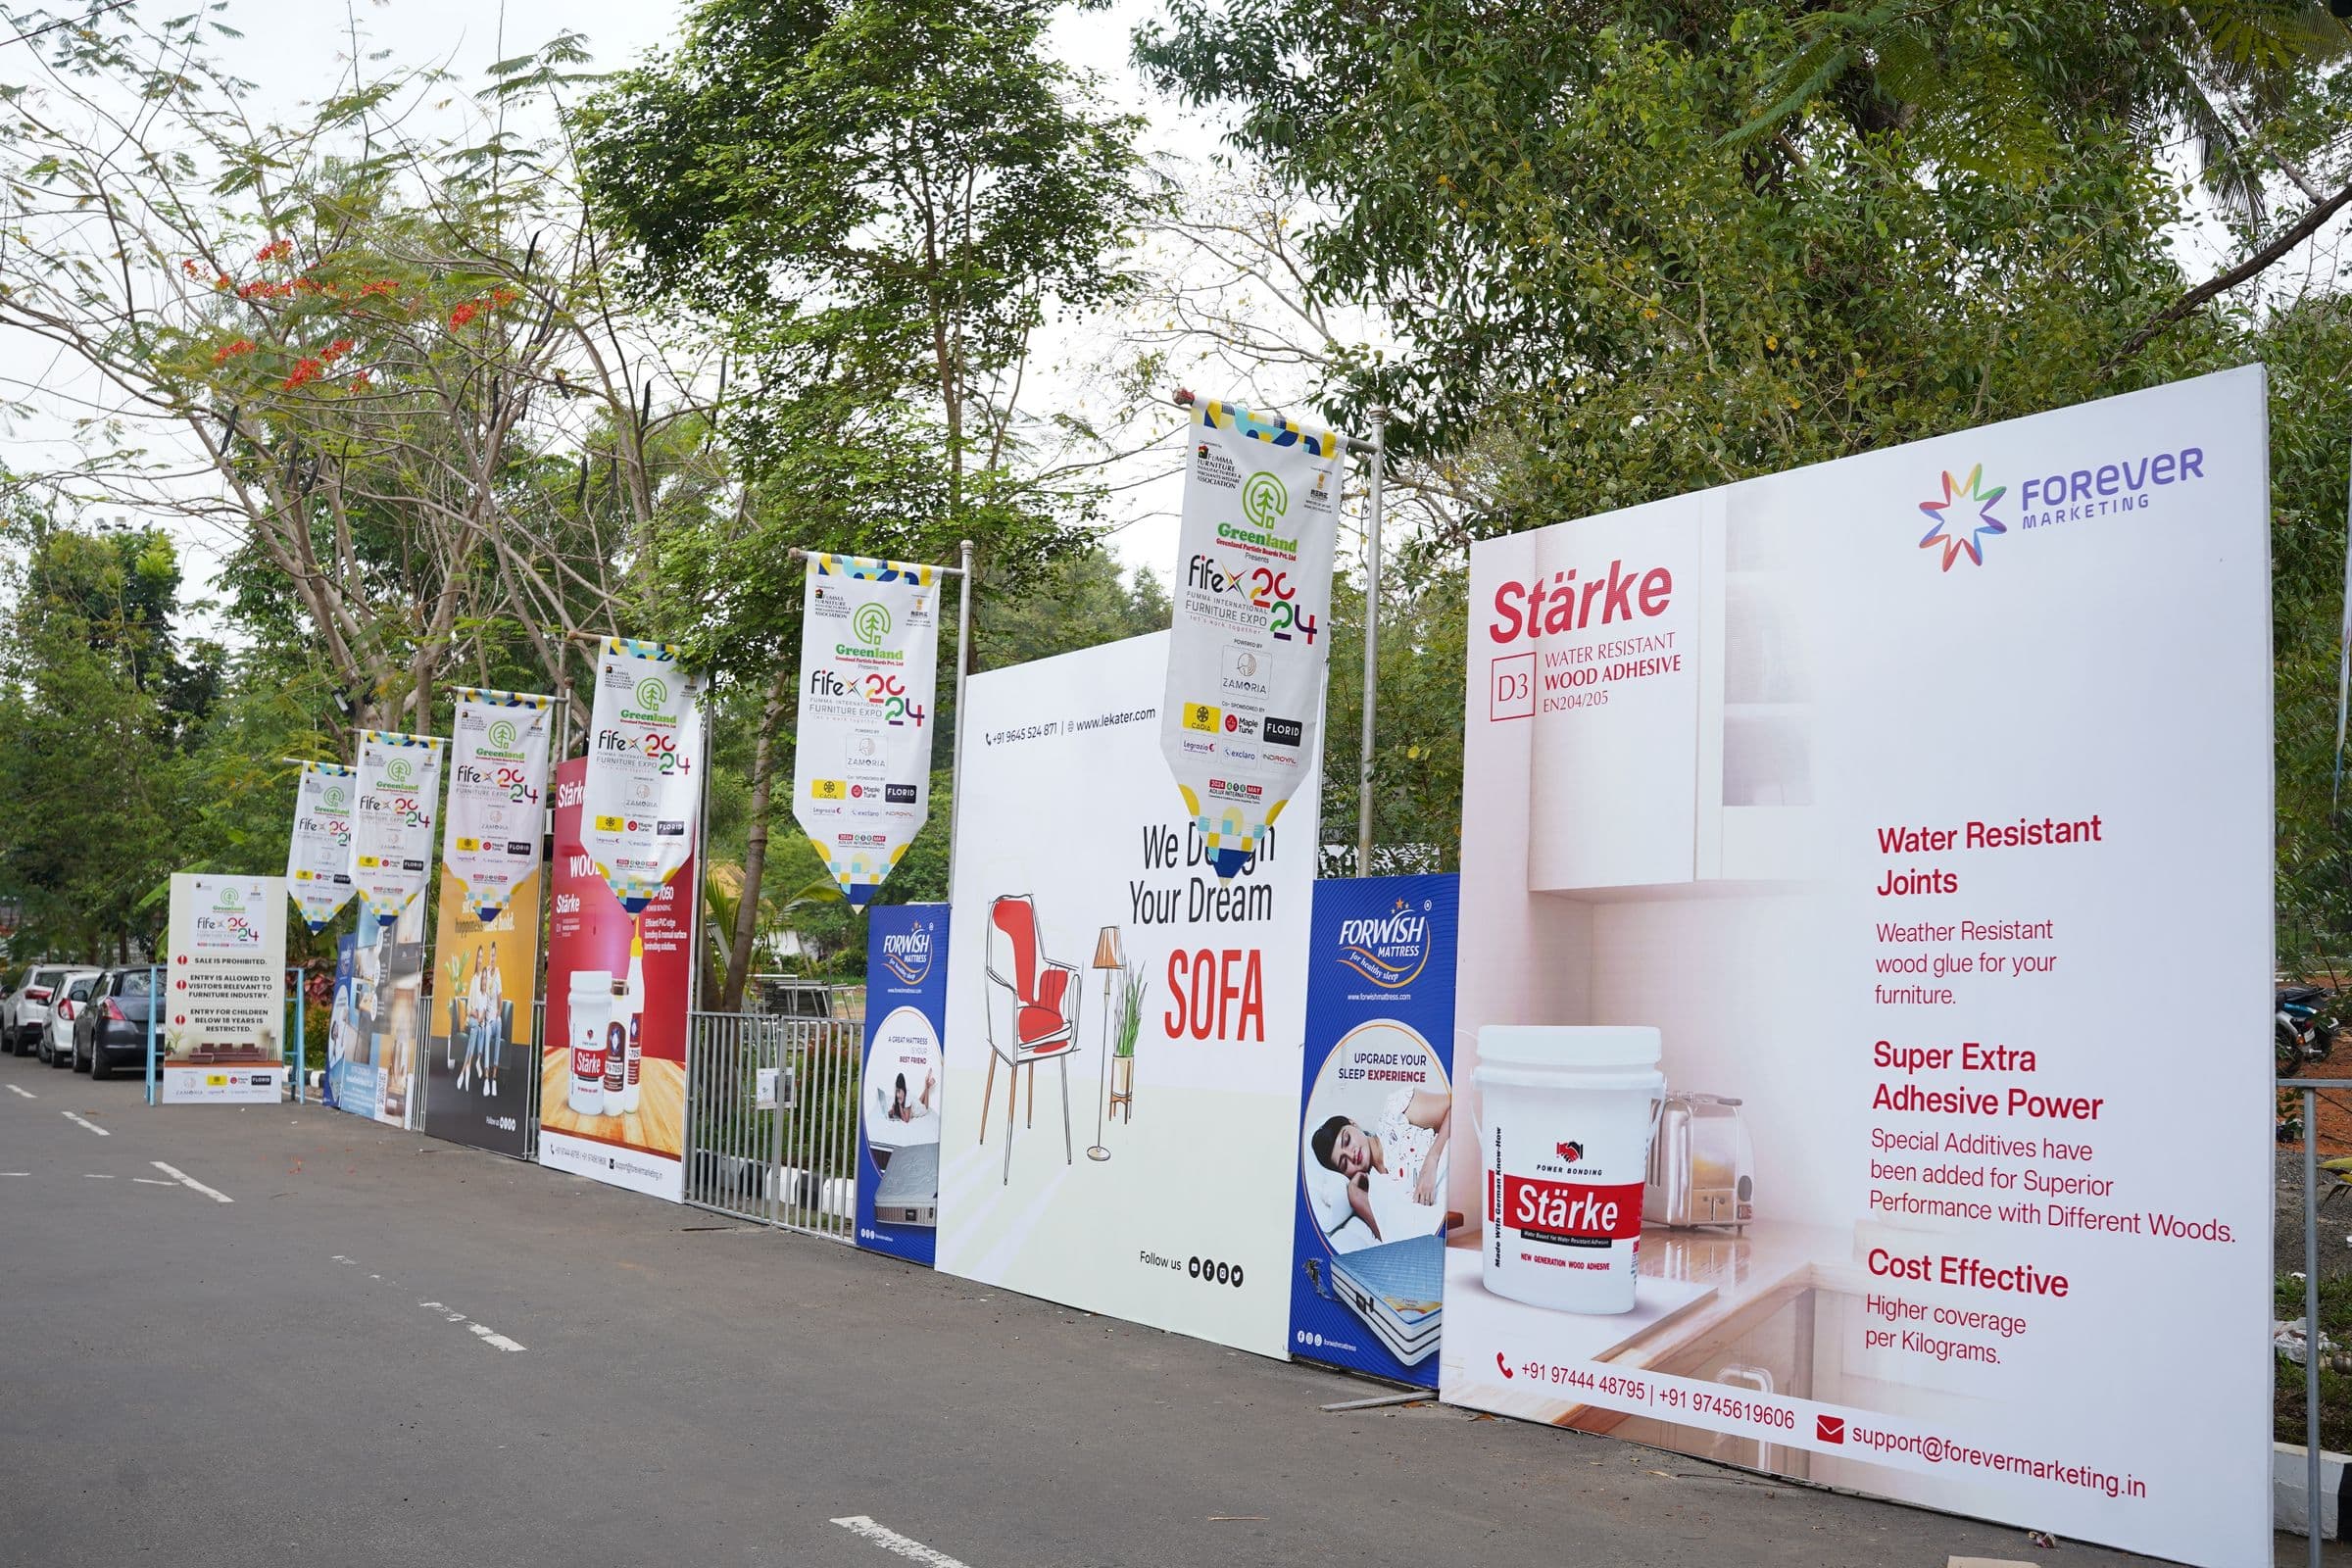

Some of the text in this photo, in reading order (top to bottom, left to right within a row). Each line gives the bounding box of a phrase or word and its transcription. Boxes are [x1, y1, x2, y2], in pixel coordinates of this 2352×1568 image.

[2023, 494, 2149, 529] MARKETING
[1217, 522, 1298, 554] Greenland
[1186, 600, 1267, 626] FURNITURE EXPO
[1187, 591, 1268, 614] FUMMA INTERNATIONAL
[1490, 560, 1672, 644] Stärke
[836, 644, 904, 661] Greenland
[1545, 631, 1677, 668] WATER RESISTANT
[1223, 677, 1266, 694] ZAMORIA
[1498, 672, 1529, 702] D3
[1544, 655, 1681, 691] WOOD ADHESIVE
[809, 705, 882, 717] FURNITURE EXPO
[1544, 690, 1608, 712] EN204/205
[620, 710, 677, 723] Greenland
[1077, 708, 1155, 731] www.lekater.com
[1239, 717, 1258, 728] Maple
[1239, 725, 1253, 735] Tune
[1267, 723, 1298, 736] FLORID
[993, 722, 1057, 745] +91 9645 524 871
[558, 780, 587, 808] Stärk
[887, 788, 915, 797] FLORID
[1144, 824, 1178, 869] We
[1878, 814, 2102, 854] Water Resistant
[1877, 868, 1958, 896] Joints
[1130, 877, 1272, 924] Your Dream
[1339, 916, 1425, 948] FORWISH
[1877, 918, 2053, 943] Weather Resistant
[1378, 945, 1420, 957] MATTRESS
[1876, 952, 2057, 977] wood glue for your
[1349, 952, 1399, 983] for healthy sleep
[1164, 949, 1264, 1042] SOFA
[1875, 984, 1956, 1004] furniture.
[1354, 1054, 1427, 1066] UPGRADE YOUR
[1874, 1041, 2036, 1074] Super Extra
[1339, 1067, 1426, 1083] SLEEP EXPERIENCE
[1873, 1083, 2104, 1120] Adhesive Power
[1872, 1128, 2093, 1160] Special Additives have
[1537, 1164, 1563, 1173] POWER
[1871, 1159, 2114, 1198] been added for Superior
[1516, 1184, 1619, 1232] Stärke
[1870, 1190, 2236, 1243] Performance with Different Woods.
[1140, 1250, 1182, 1271] Follow us
[1534, 1254, 1566, 1267] GENERATION
[1868, 1248, 2069, 1298] Cost Effective
[1866, 1294, 2027, 1338] Higher coverage
[1866, 1329, 2001, 1364] per Kilograms.
[1522, 1363, 1795, 1430] +91 97444 48795 +91 9745619606
[1852, 1425, 2147, 1499] support@forevermarketing.in
